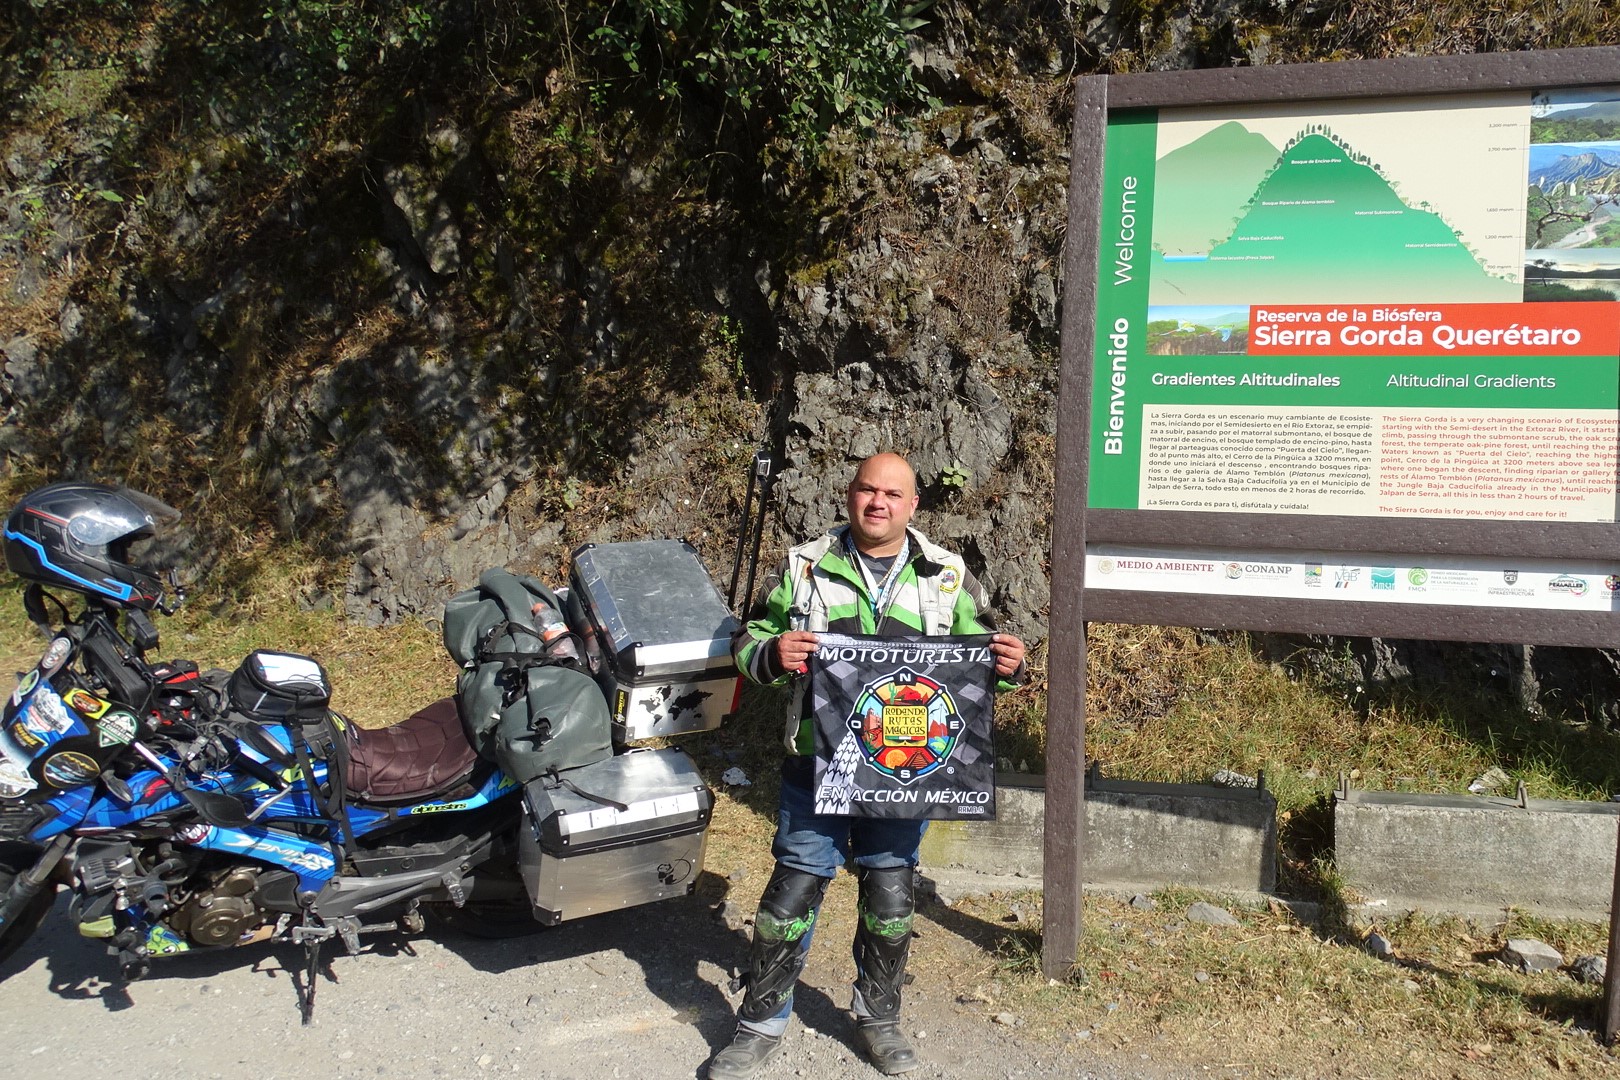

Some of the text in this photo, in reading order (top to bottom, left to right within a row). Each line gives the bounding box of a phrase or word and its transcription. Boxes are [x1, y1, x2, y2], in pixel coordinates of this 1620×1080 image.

[1114, 176, 1137, 285] Welcome
[1257, 308, 1442, 322] Reserva de la Biósfera
[1254, 324, 1581, 349] Sierra Gorda Querétaro
[1104, 318, 1129, 455] Bienvenido
[1152, 373, 1340, 387] Gradientes Altitudinales
[1386, 374, 1556, 388] Altitudinal Gradients
[1117, 560, 1214, 572] MEDIO AMBIENTE
[1245, 565, 1292, 574] CONANP
[1371, 580, 1394, 590] Ramsar
[819, 647, 991, 663] MOTOTURISTA
[851, 720, 861, 728] O
[900, 770, 910, 778] S
[820, 786, 990, 804] EN ACCIÓN MÉXICO
